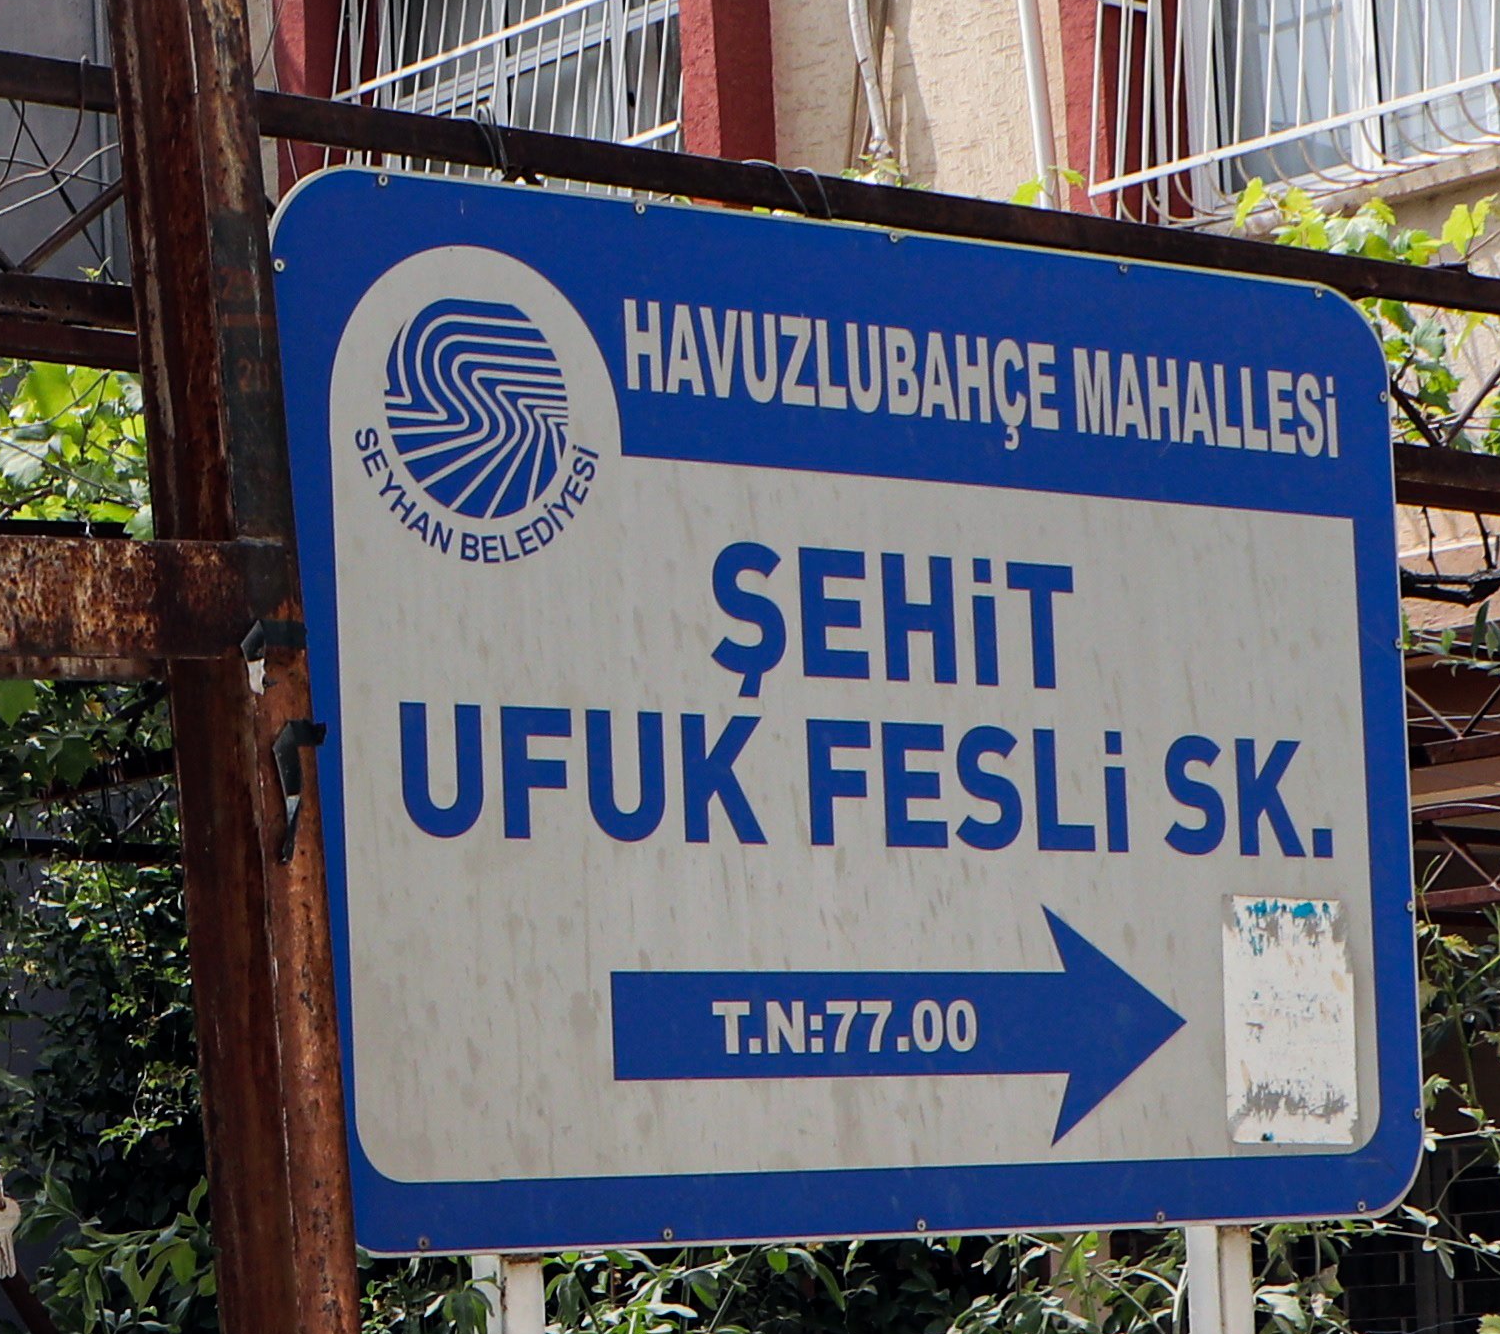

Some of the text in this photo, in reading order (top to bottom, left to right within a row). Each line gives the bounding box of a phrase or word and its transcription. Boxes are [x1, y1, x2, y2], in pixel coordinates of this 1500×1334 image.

[621, 297, 1062, 451] HAVUZLUBAHÇE
[353, 426, 600, 565] SEYHAN BELEDİYESİ
[399, 700, 769, 848] UFUK
[1163, 734, 1336, 860] SK.
